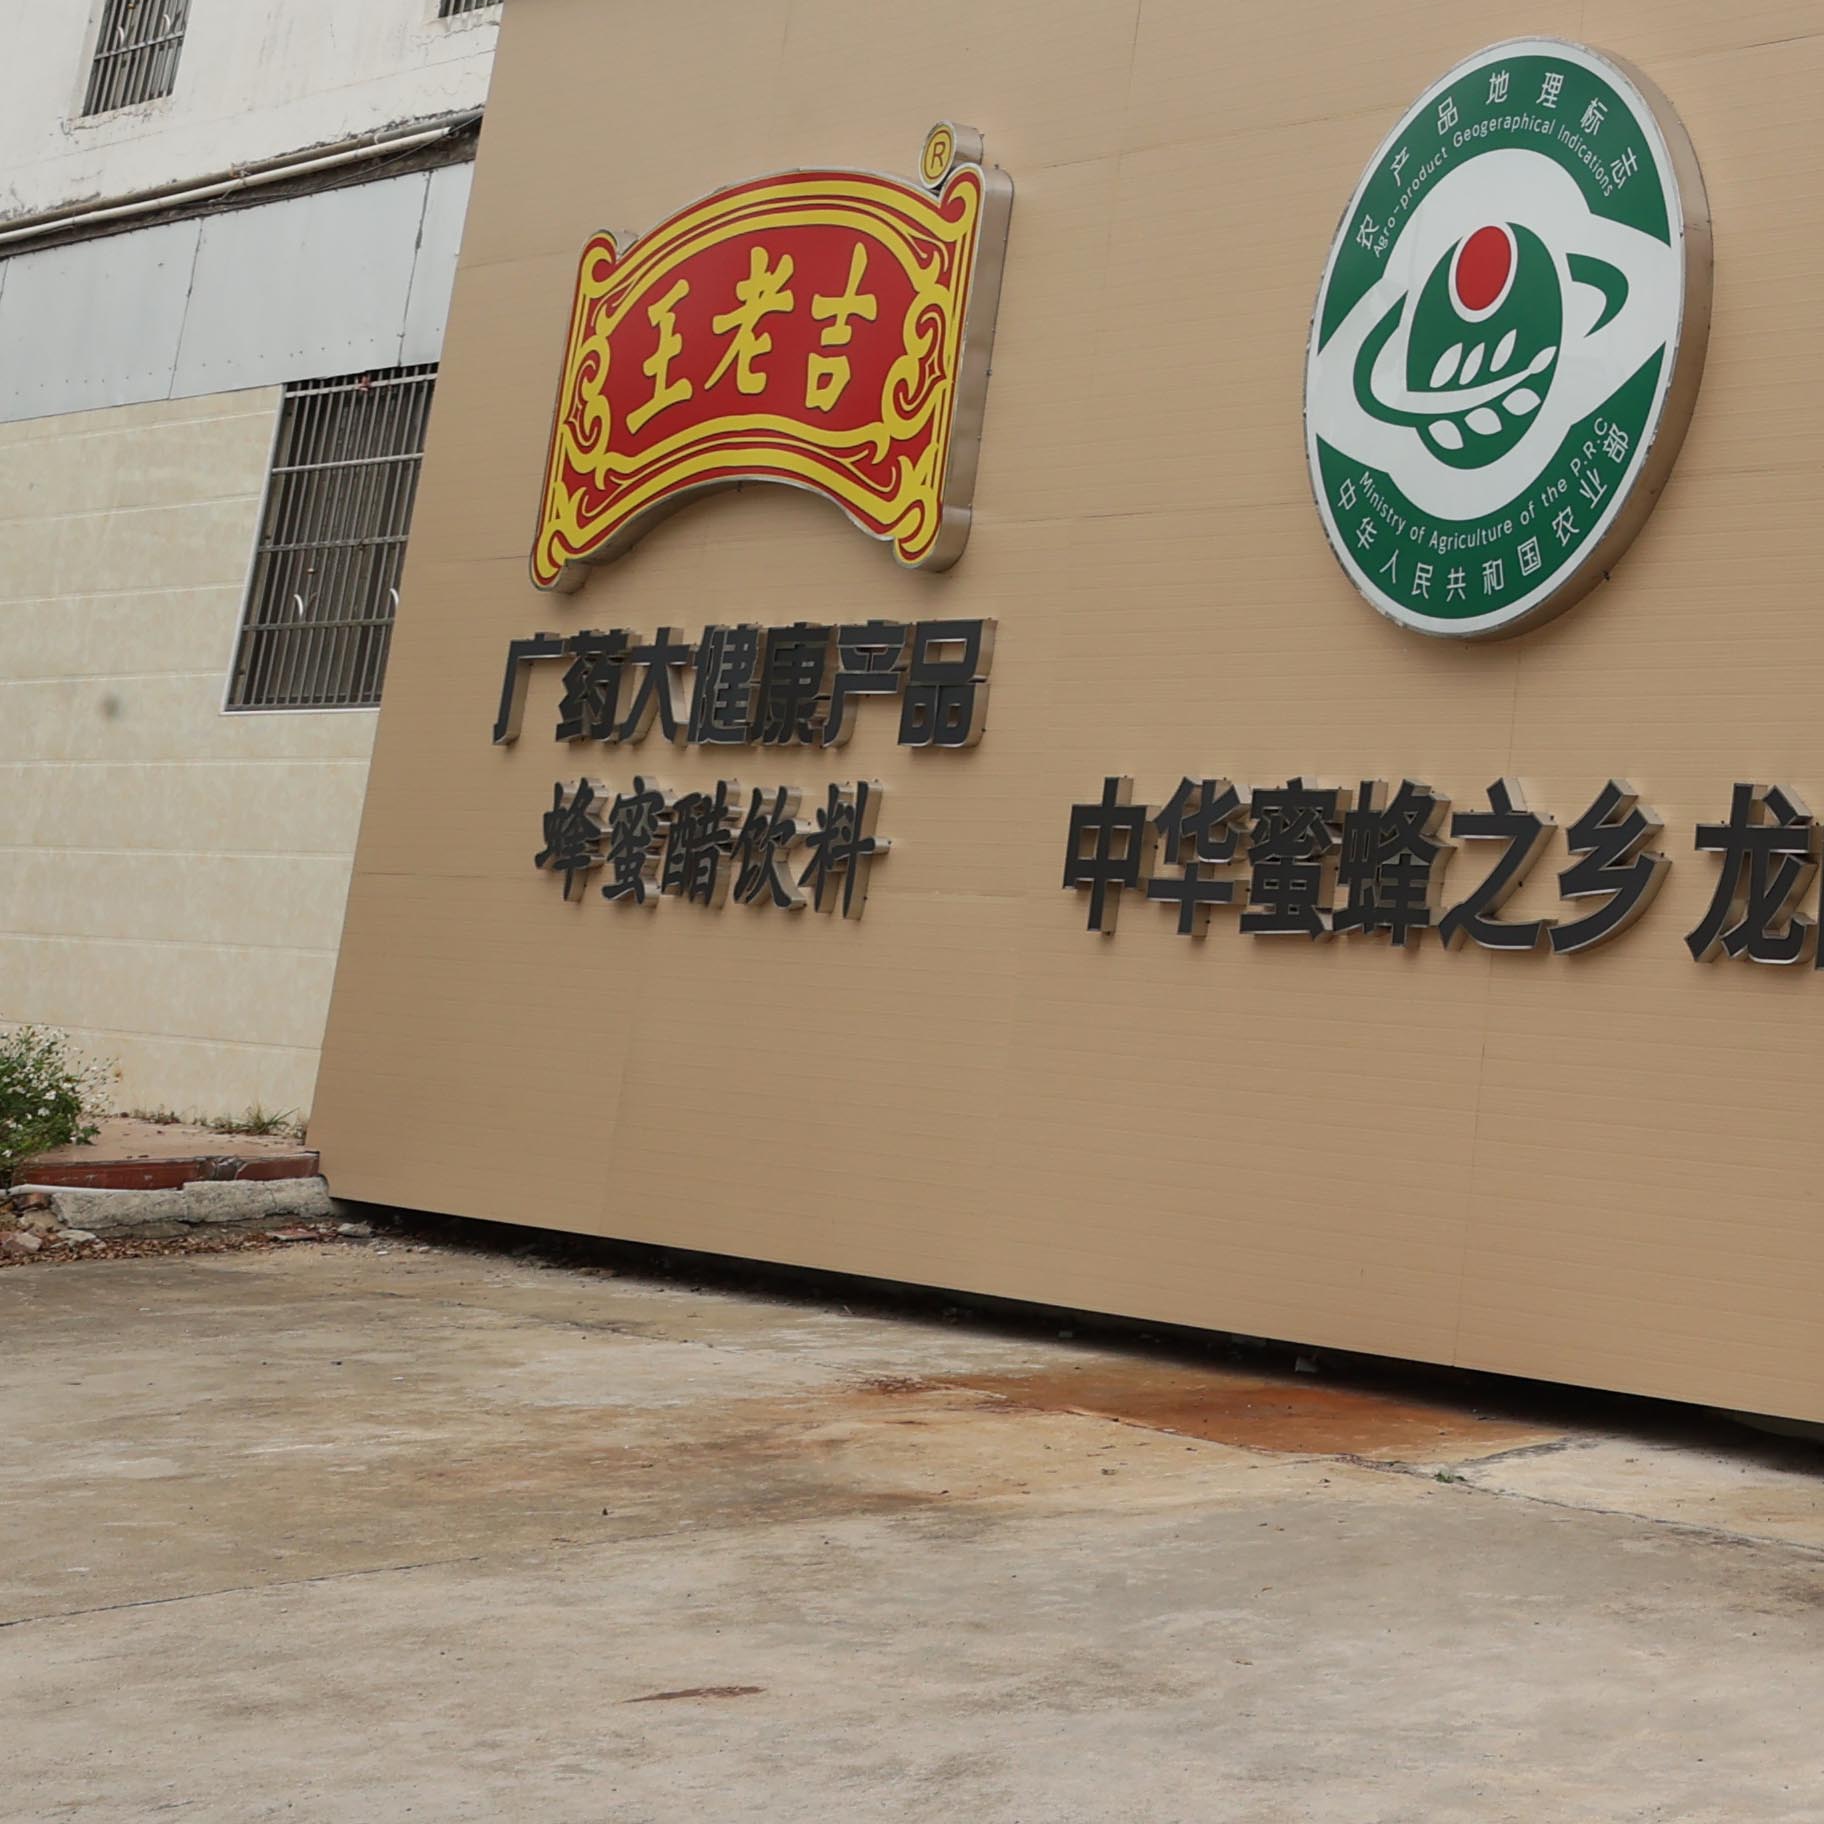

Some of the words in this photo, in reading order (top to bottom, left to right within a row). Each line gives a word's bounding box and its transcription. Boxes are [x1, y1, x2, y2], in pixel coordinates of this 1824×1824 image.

[1356, 69, 1638, 250] 农产品地理标志
[1373, 146, 1449, 259] Agro-product
[1452, 112, 1556, 148] Geogeraphical
[1557, 124, 1614, 197] Indications
[623, 238, 878, 439] 王老吉
[1337, 423, 1629, 603] 中华人民共和国农业部
[1359, 471, 1405, 535] Ministry
[1409, 525, 1426, 543] of
[1428, 518, 1514, 555] Agriculture
[1519, 499, 1537, 526] of
[1540, 477, 1568, 508] the
[492, 619, 992, 749] 广药大健康产品
[534, 776, 886, 921] 蜂蜜醋饮料
